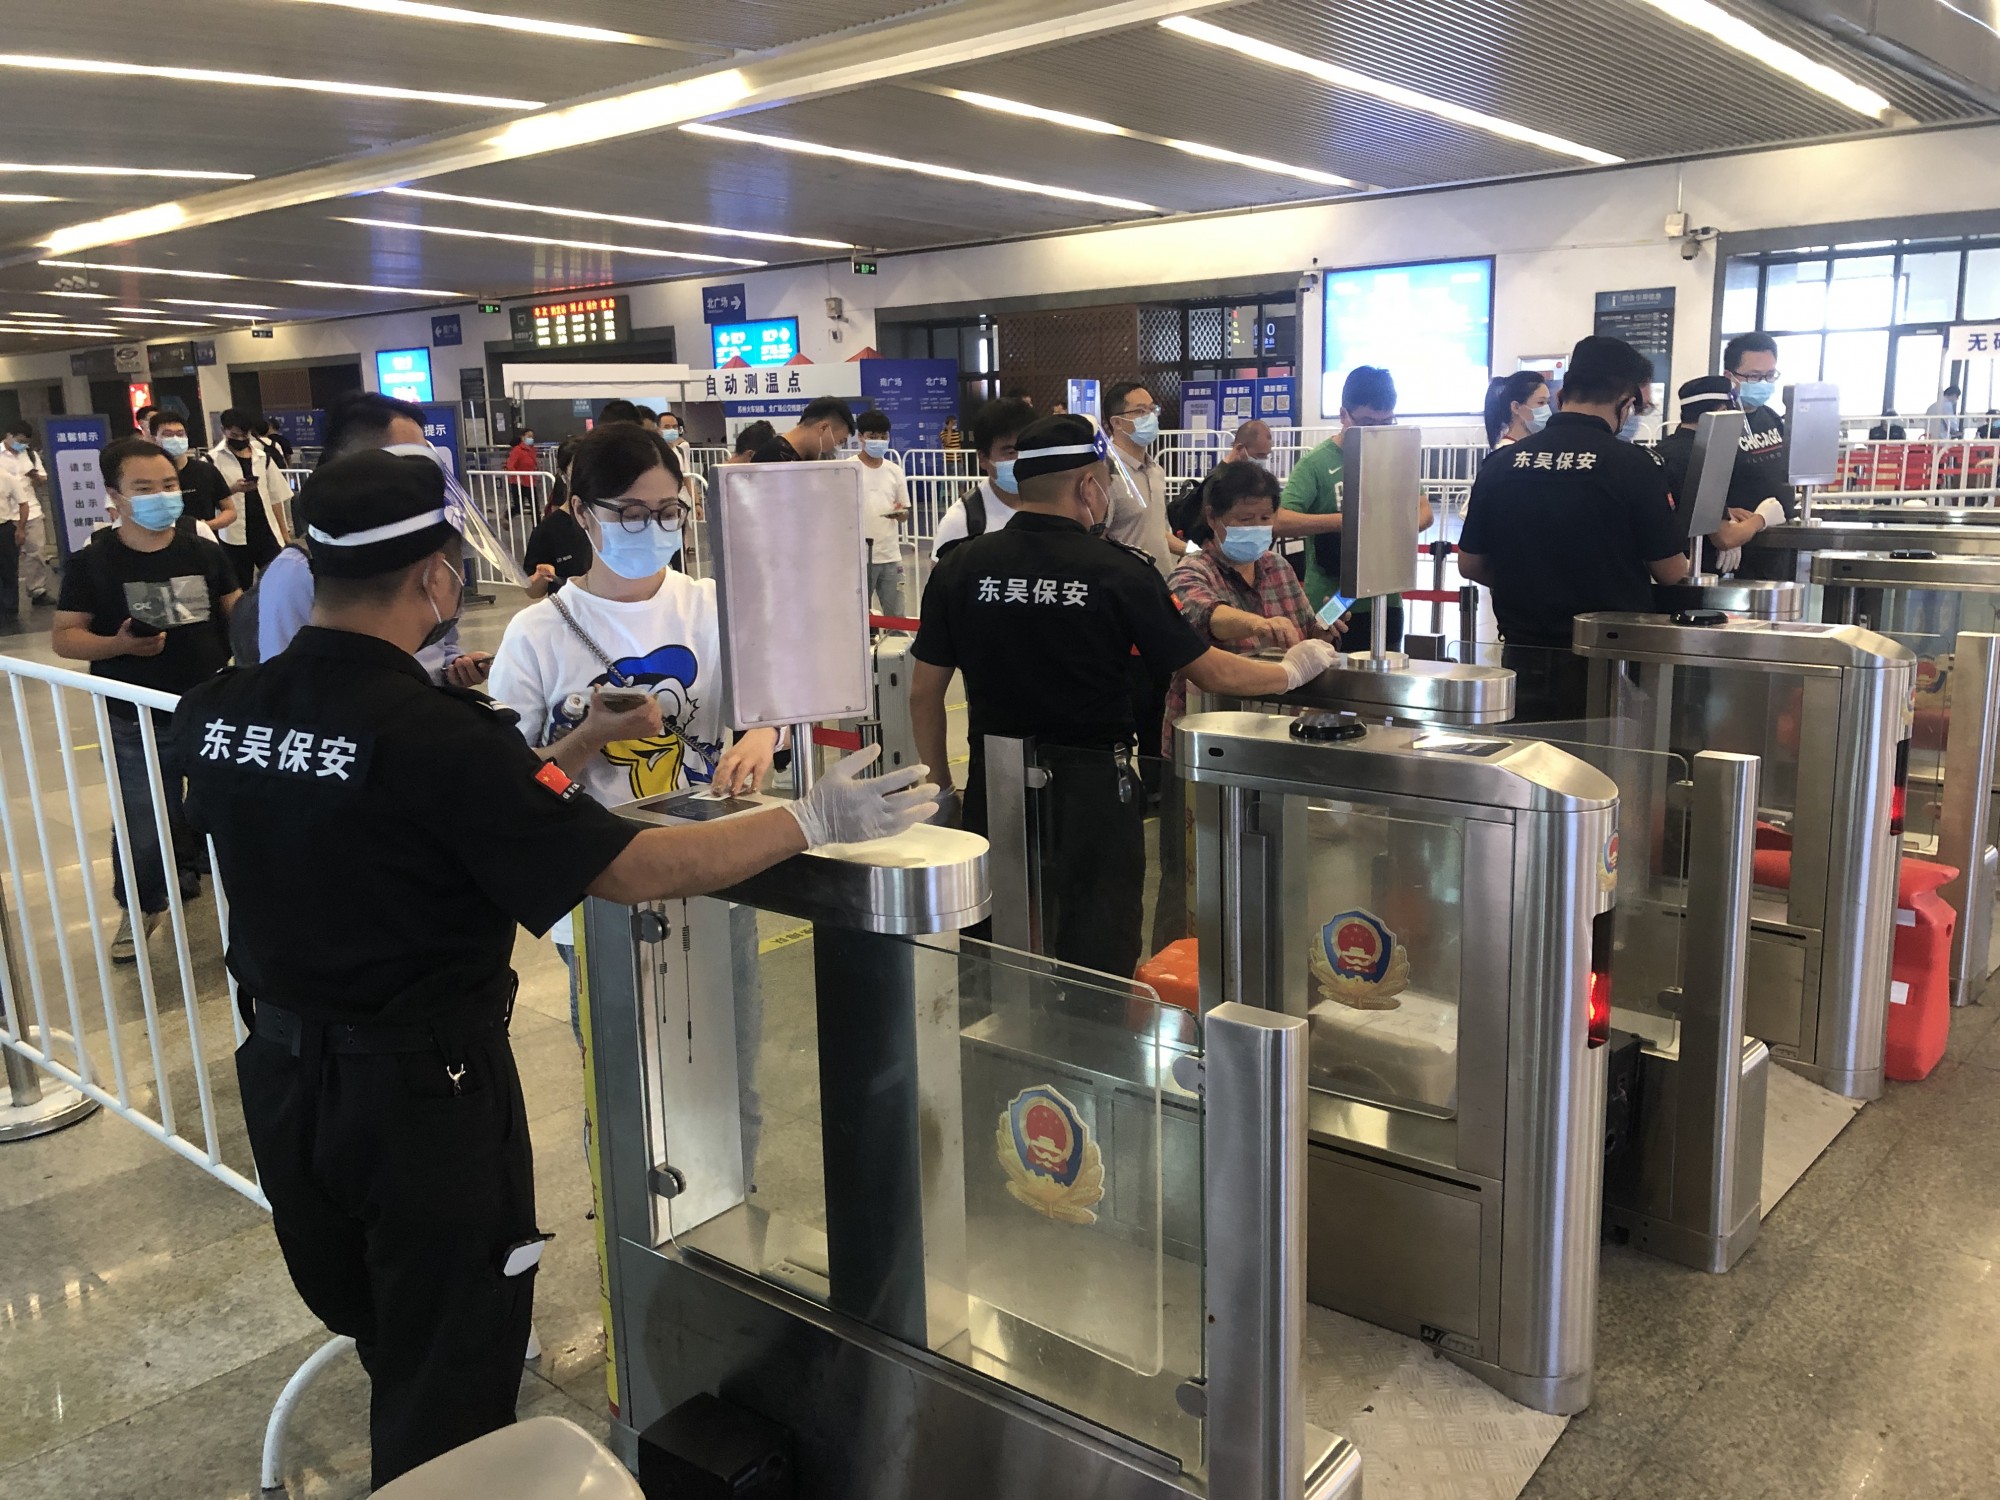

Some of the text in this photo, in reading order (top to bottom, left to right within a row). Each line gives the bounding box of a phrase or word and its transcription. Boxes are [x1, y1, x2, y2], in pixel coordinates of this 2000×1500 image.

[706, 371, 801, 396] 自动测温点
[56, 432, 99, 443] 温馨提示
[1739, 427, 1783, 452] CHICAGO
[69, 462, 93, 472] 请您
[1512, 451, 1598, 471] 东吴保安
[72, 481, 96, 491] 主动
[75, 499, 98, 509] 出示
[977, 576, 1090, 607] 东吴保安
[198, 718, 358, 780] 东吴保安
